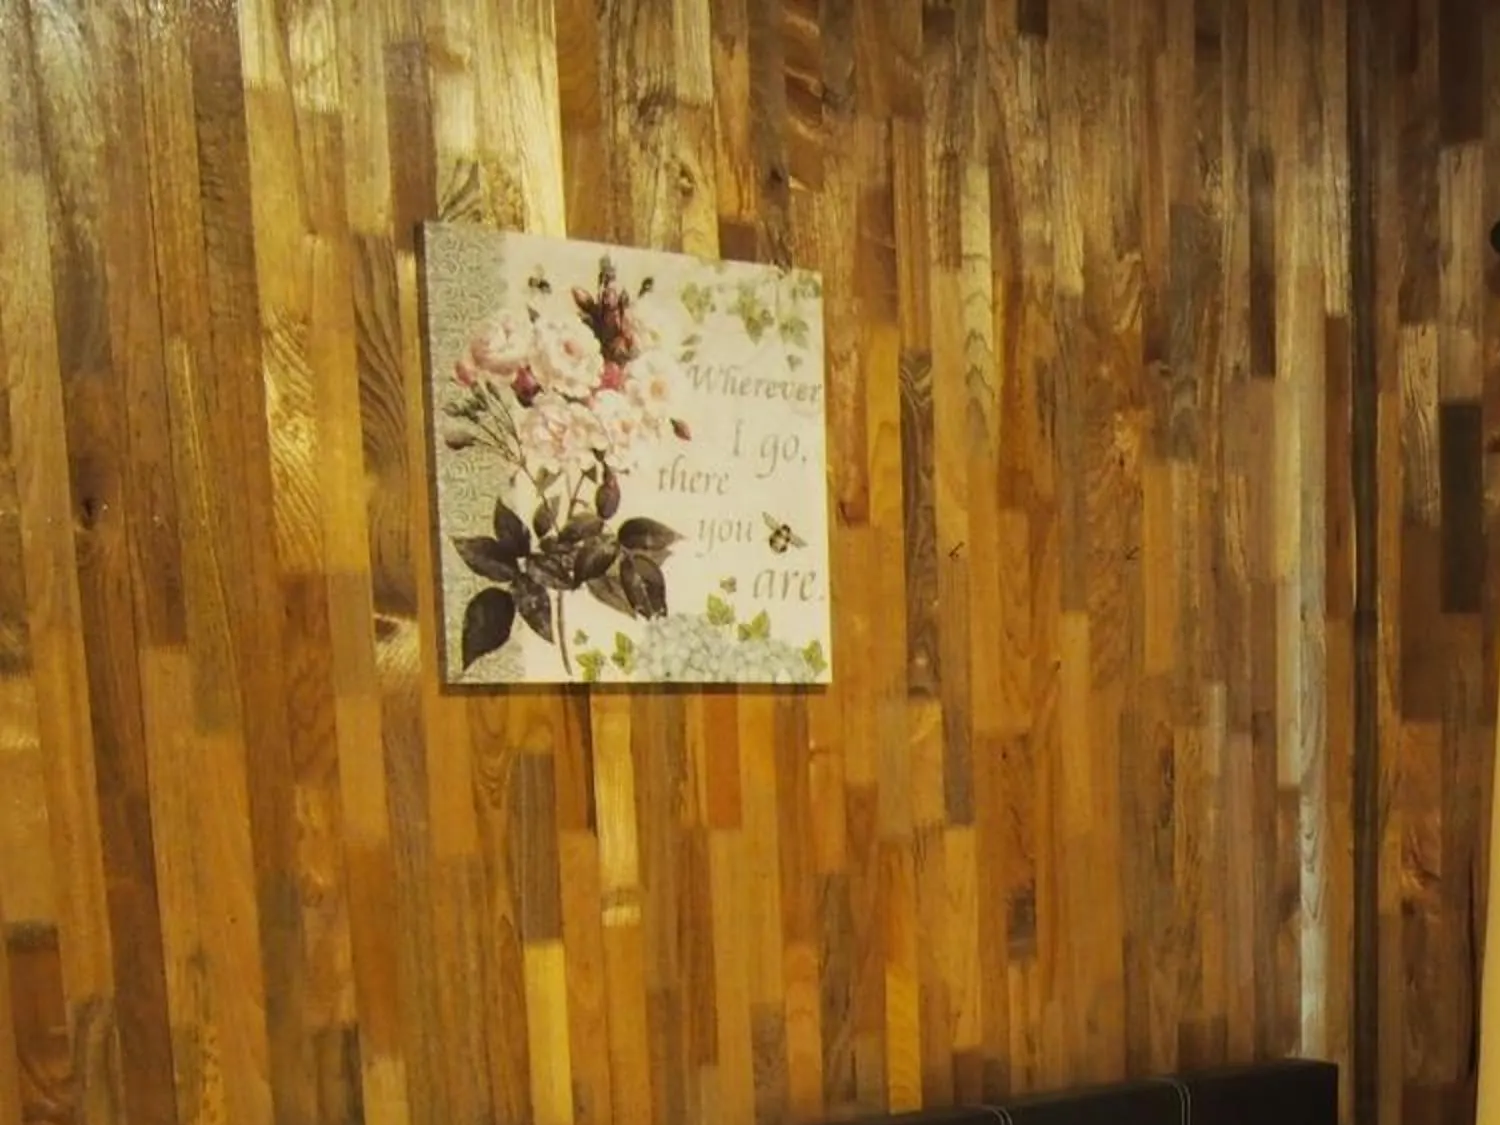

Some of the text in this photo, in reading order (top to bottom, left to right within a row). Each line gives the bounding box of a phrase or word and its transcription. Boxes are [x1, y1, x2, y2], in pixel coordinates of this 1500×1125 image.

[686, 364, 822, 404] Wherever
[733, 418, 743, 456] I
[658, 454, 730, 495] there
[695, 518, 753, 558] you
